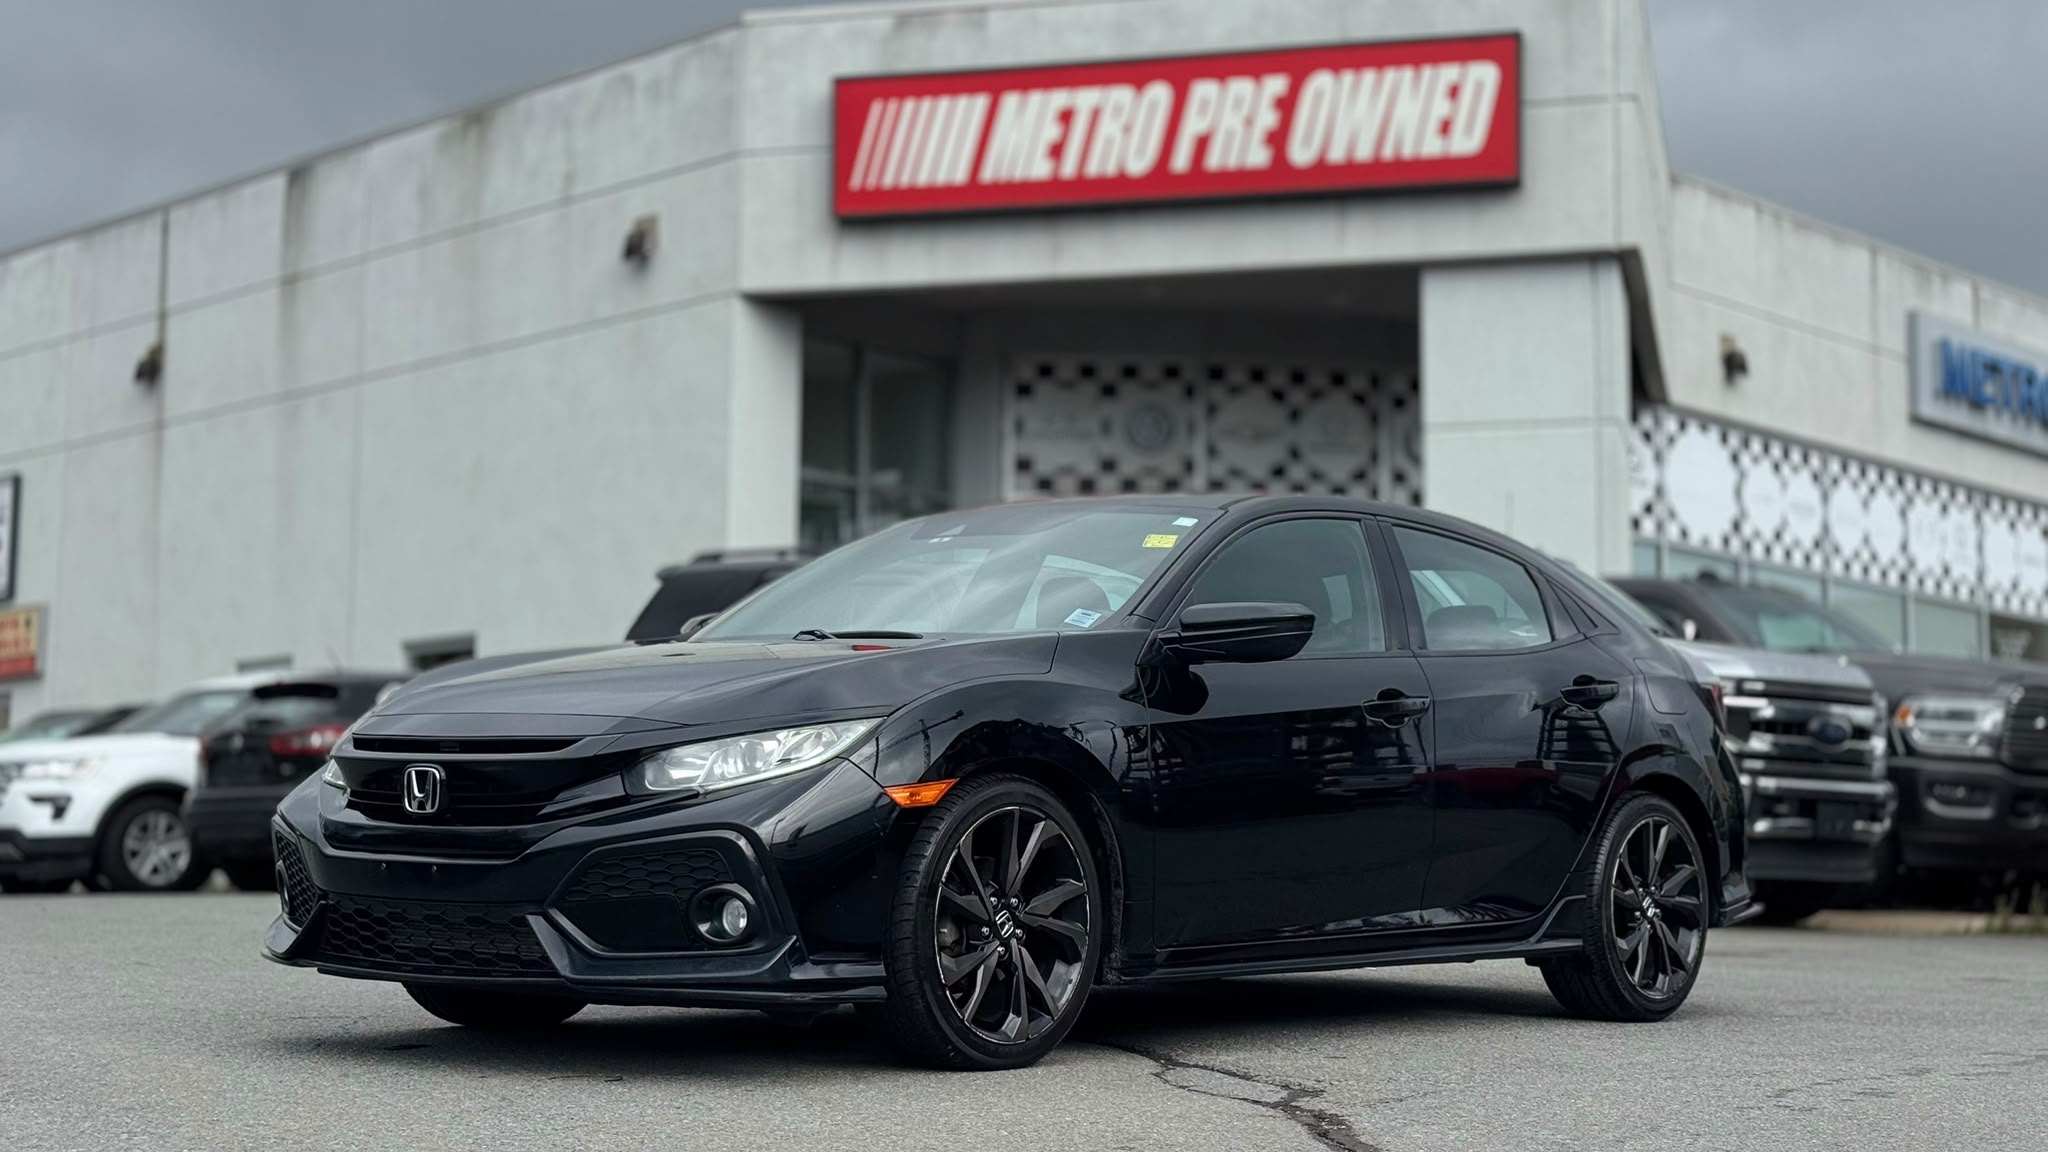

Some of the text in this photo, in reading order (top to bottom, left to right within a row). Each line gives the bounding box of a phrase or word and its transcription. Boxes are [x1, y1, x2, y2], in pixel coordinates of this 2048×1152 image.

[979, 61, 1501, 182] METRO PRE OWNED
